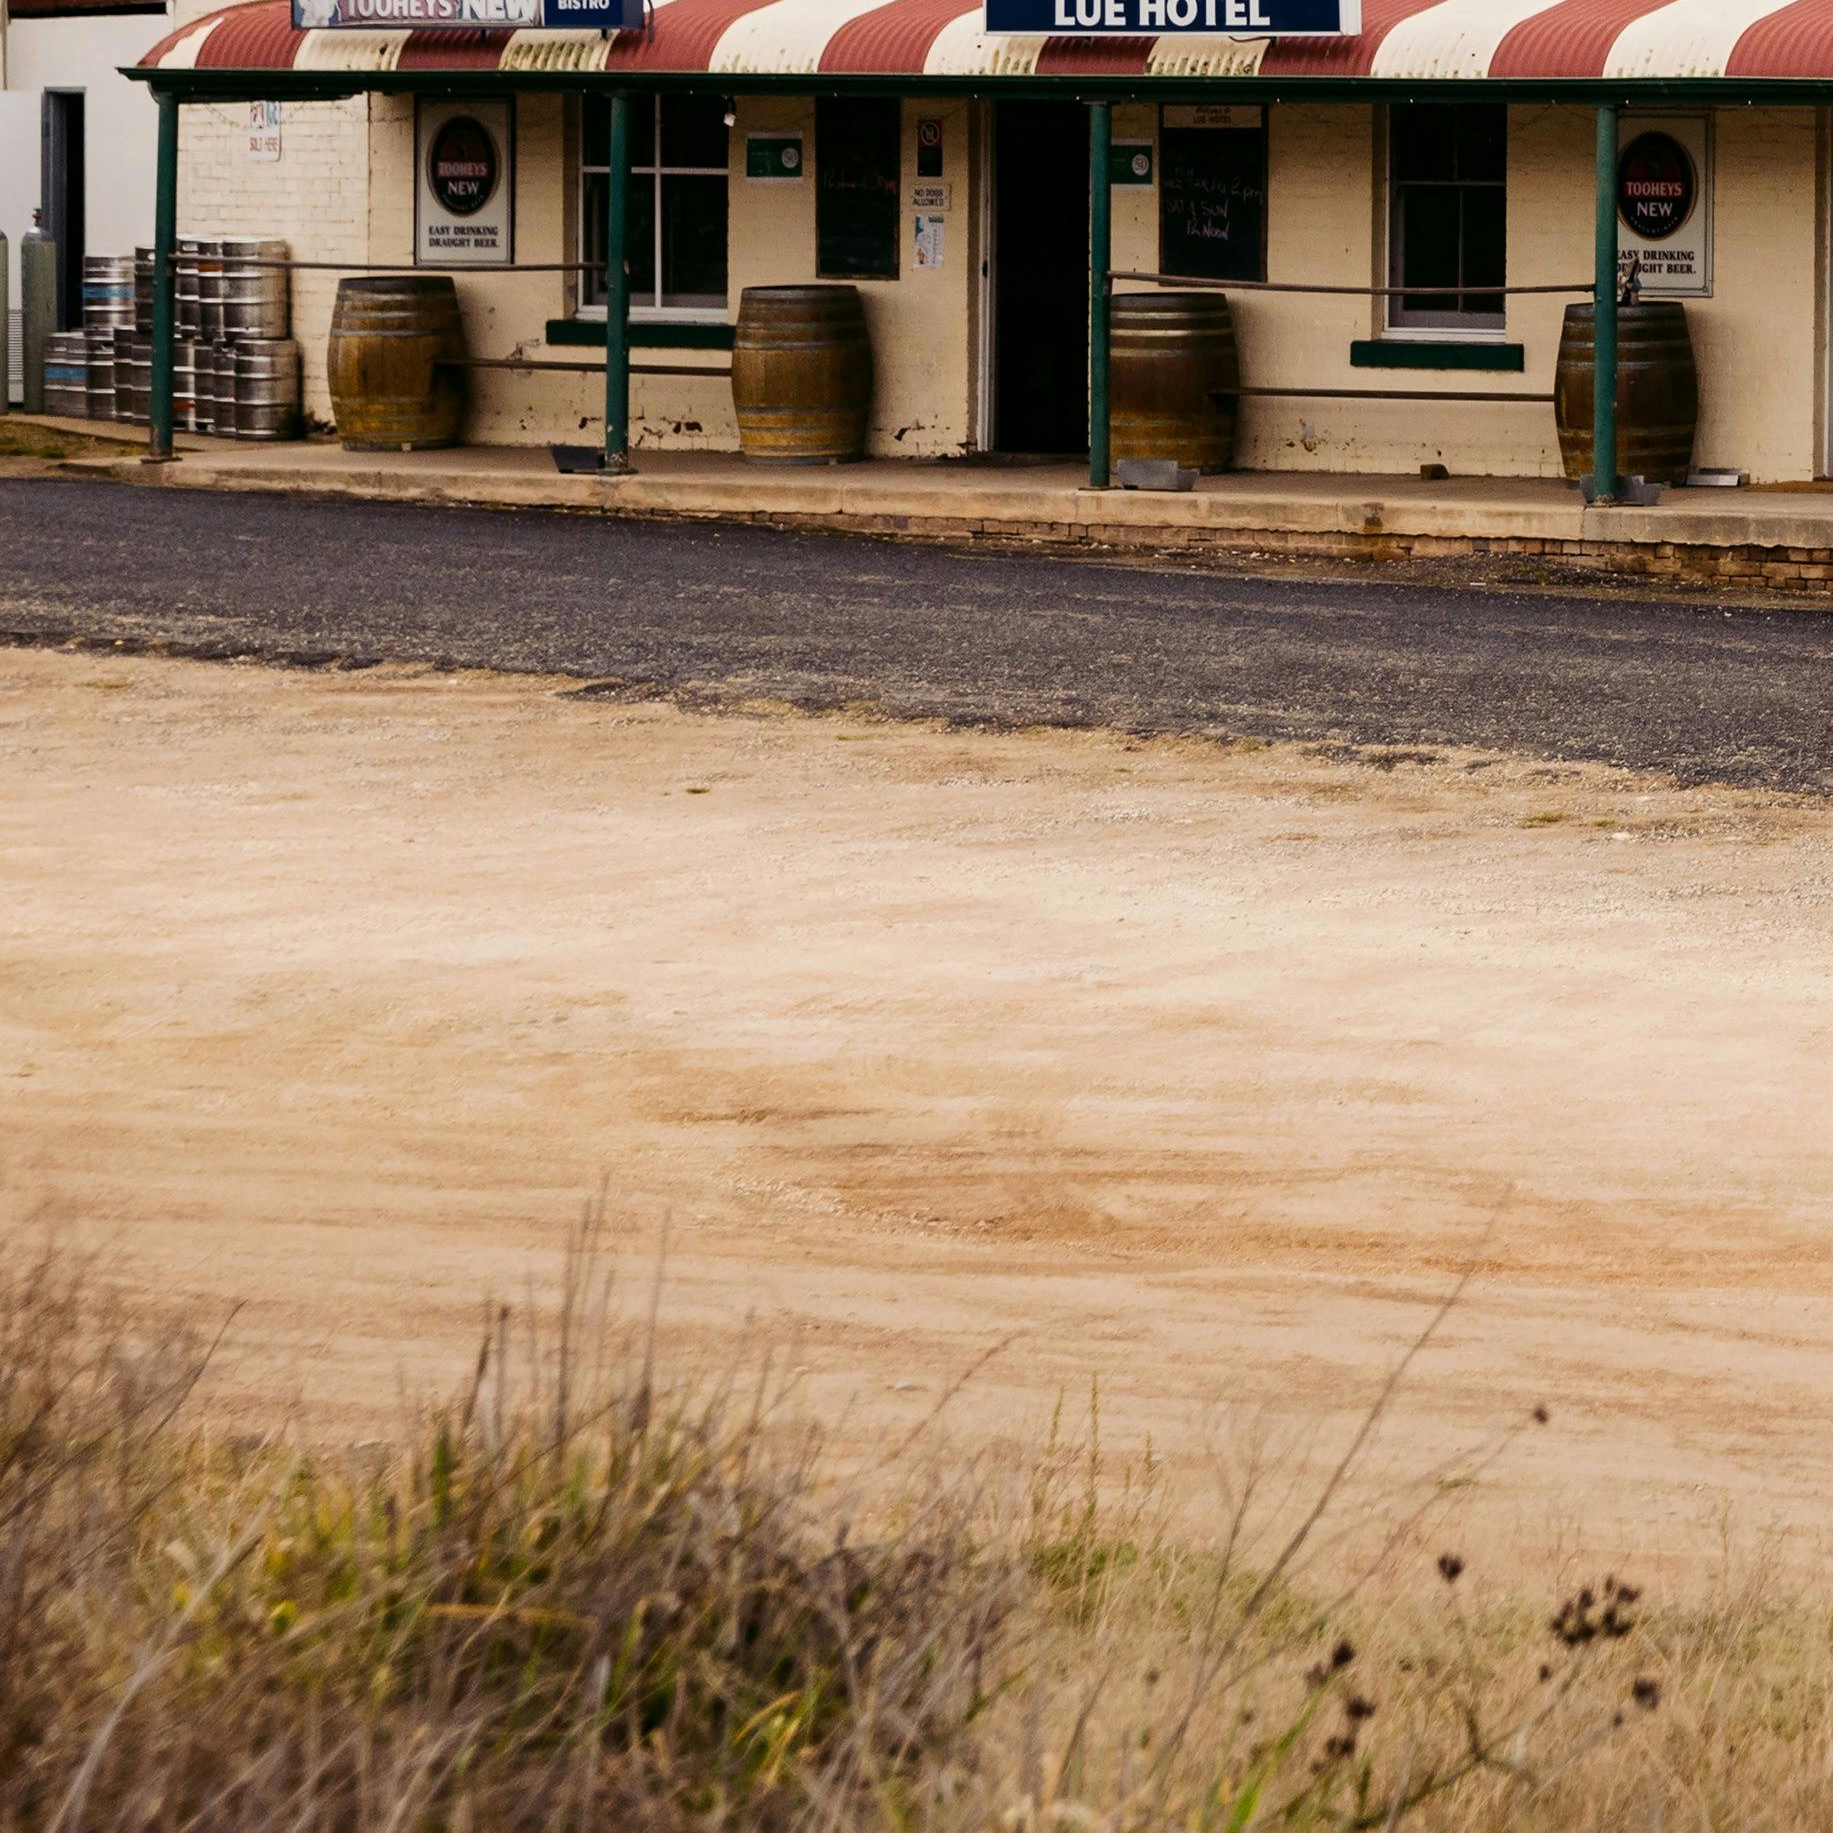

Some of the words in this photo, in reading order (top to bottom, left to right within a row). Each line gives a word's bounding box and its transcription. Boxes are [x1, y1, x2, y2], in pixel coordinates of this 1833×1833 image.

[438, 162, 488, 177] TOOHEYS
[448, 181, 479, 195] NEW
[914, 188, 924, 197] NO
[1626, 181, 1682, 197] TOOHEYS
[1637, 202, 1673, 216] NEW
[428, 226, 450, 236] EASY
[453, 226, 498, 236] DRINKING
[429, 238, 470, 248] DRAUGHT
[474, 238, 499, 248] BEER.
[1643, 250, 1694, 260] DRINKING
[1667, 263, 1696, 274] BEER.
